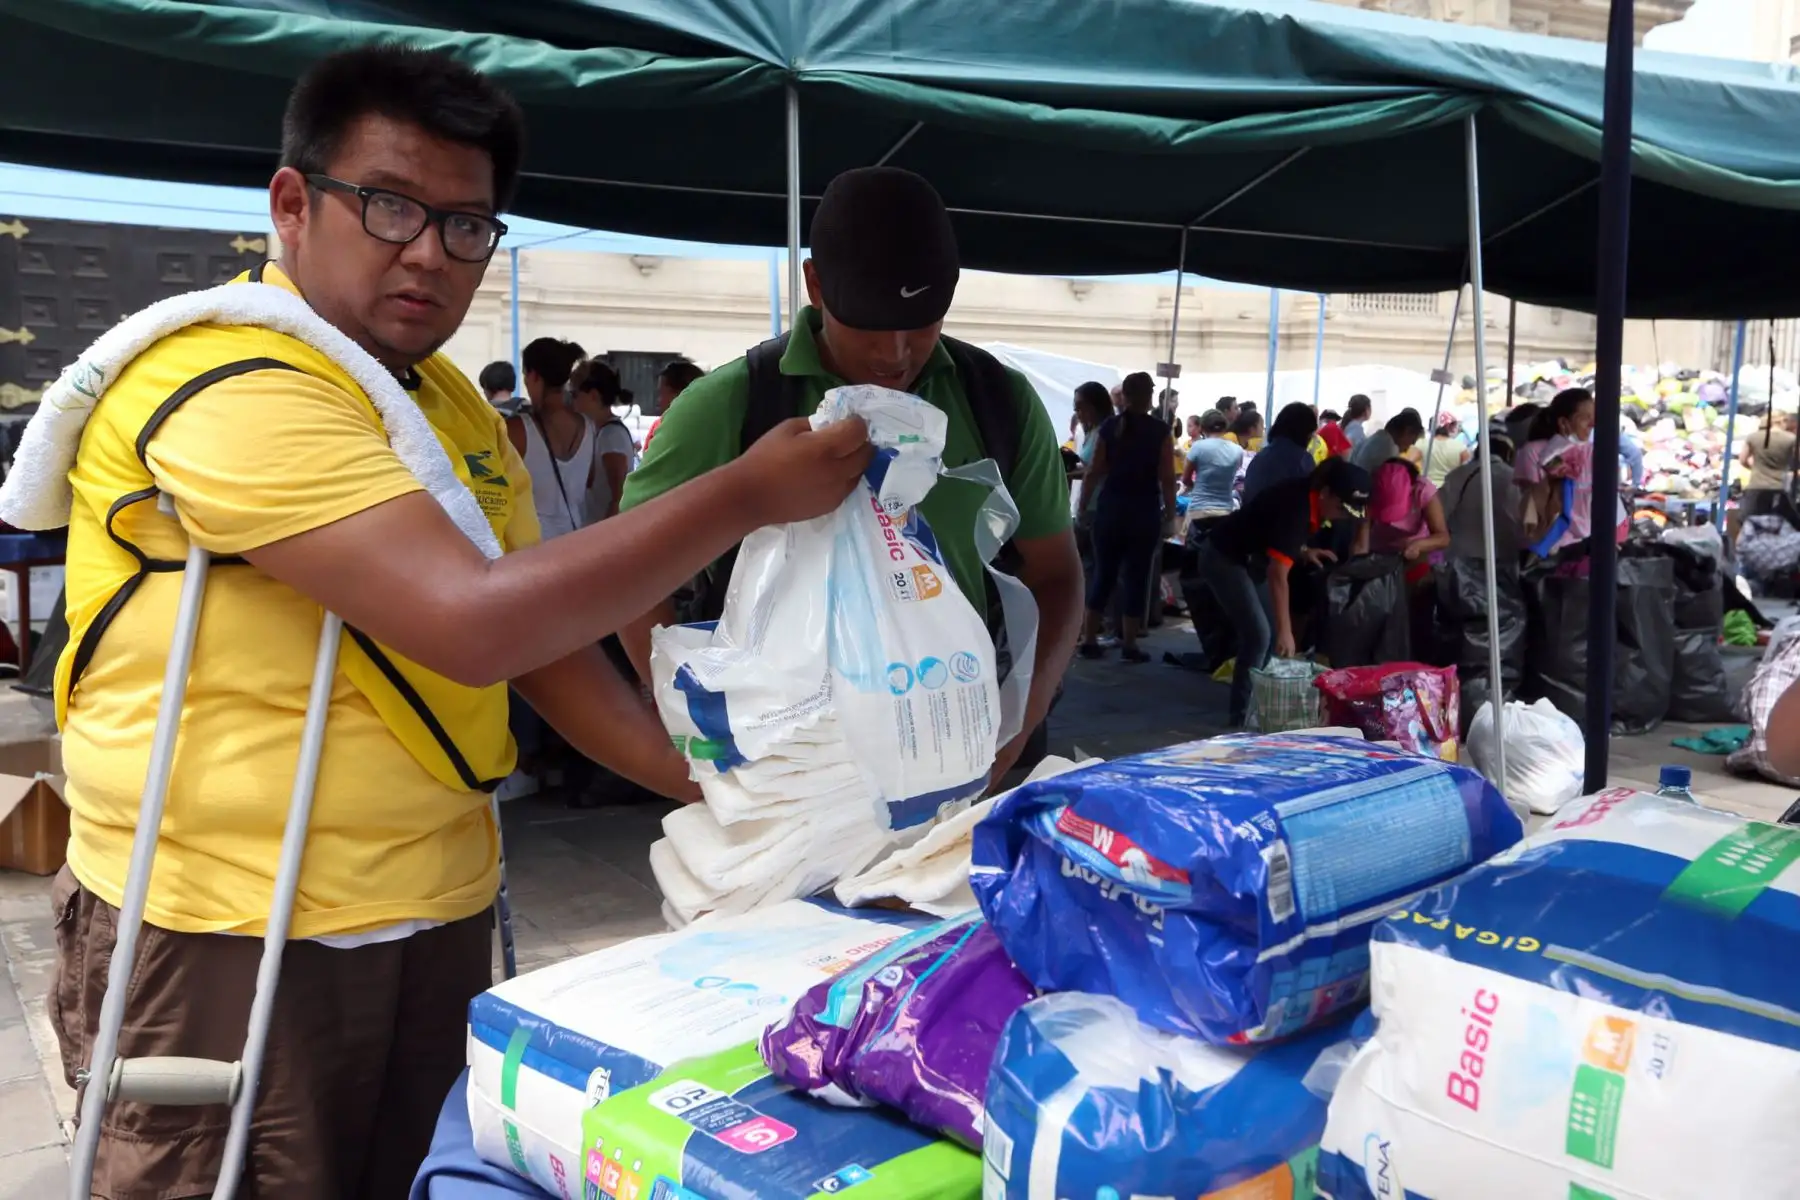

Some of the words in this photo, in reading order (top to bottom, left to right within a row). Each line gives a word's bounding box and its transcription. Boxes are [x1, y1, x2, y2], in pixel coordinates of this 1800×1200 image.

[894, 572, 907, 587] 20
[919, 572, 937, 591] M
[1387, 910, 1541, 952] GIGAPAC
[1446, 988, 1500, 1112] Basic
[744, 1128, 779, 1147] G
[1377, 1140, 1391, 1200] ENA
